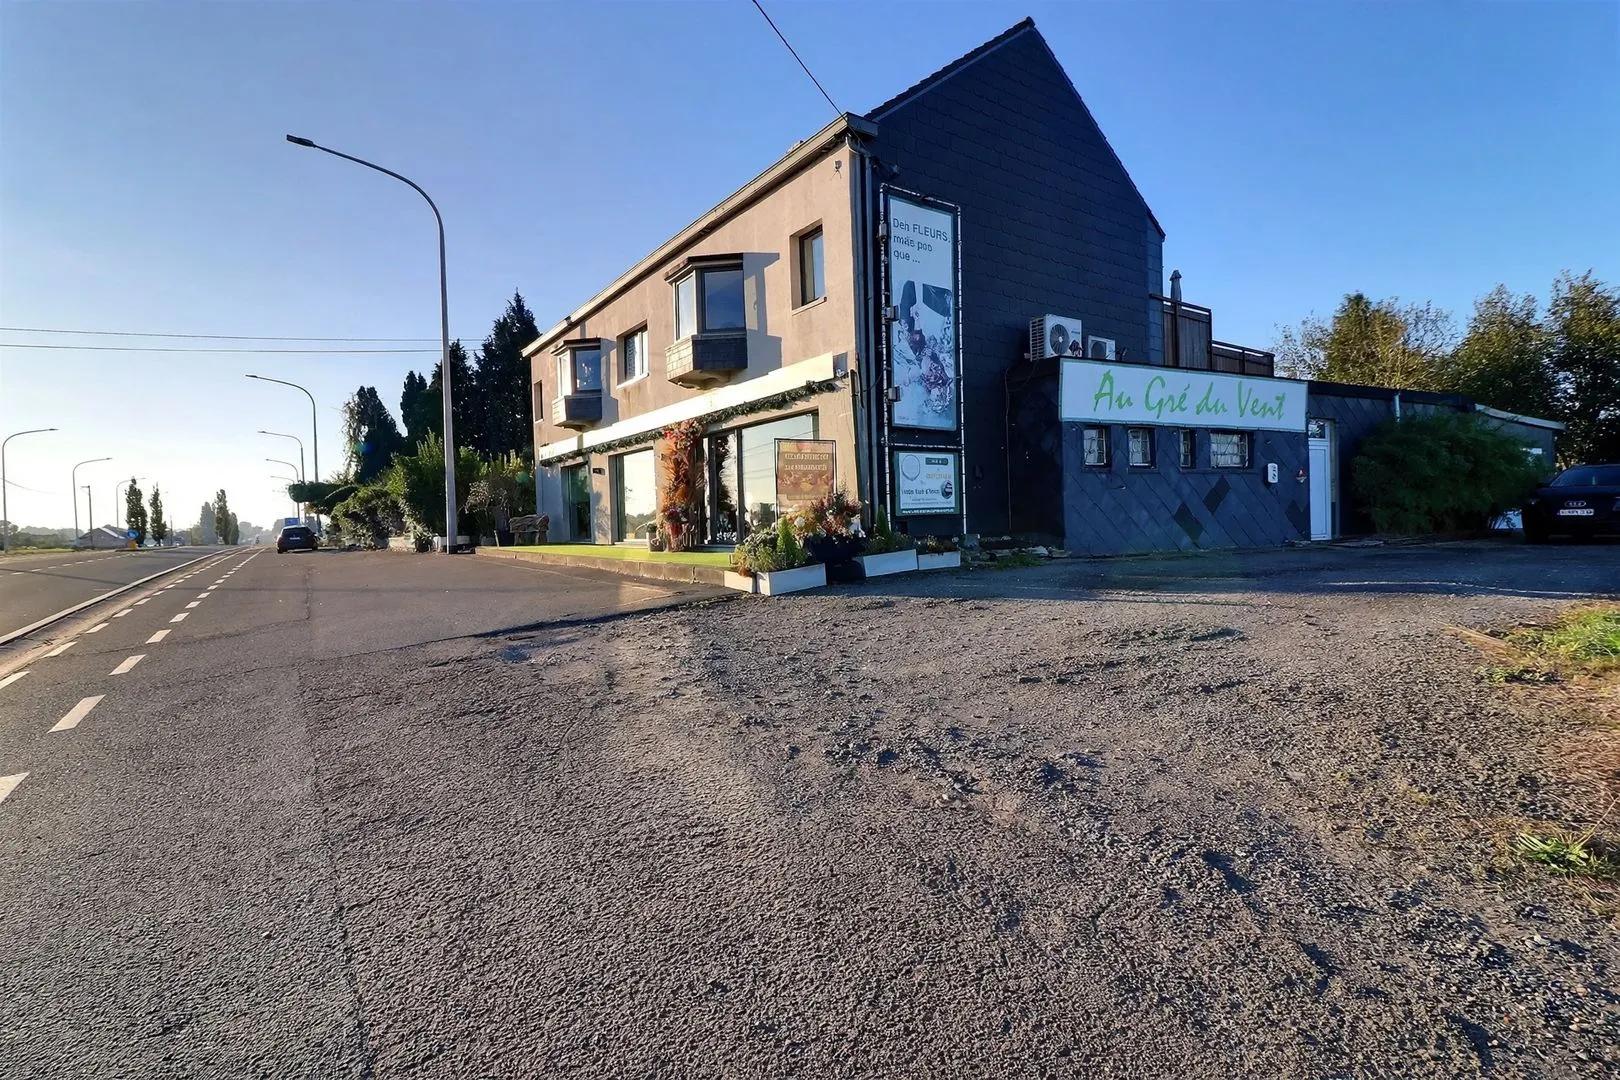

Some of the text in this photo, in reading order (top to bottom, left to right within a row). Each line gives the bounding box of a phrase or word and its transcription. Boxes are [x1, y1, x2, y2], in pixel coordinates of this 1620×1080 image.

[1093, 369, 1286, 420] Au Gré du Vent
